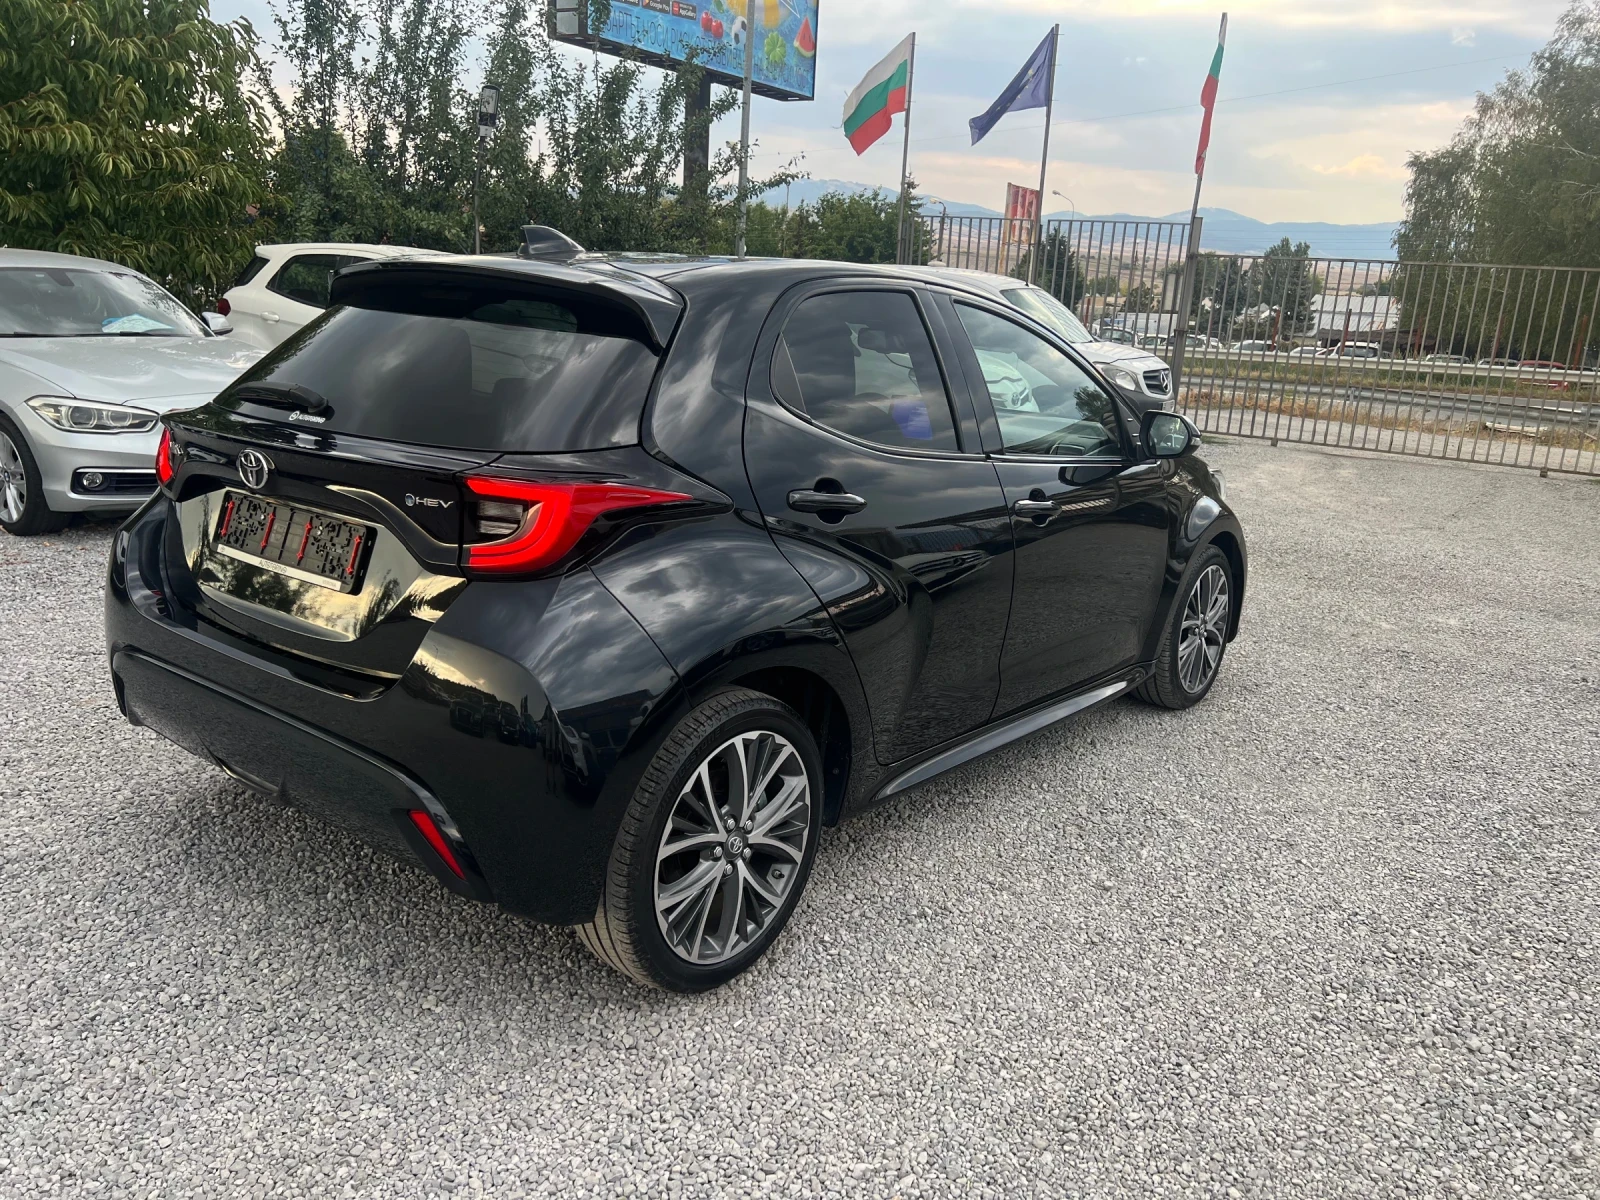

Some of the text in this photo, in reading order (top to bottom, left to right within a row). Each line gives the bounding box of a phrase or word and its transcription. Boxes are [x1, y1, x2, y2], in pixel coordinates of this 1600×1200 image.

[649, 1, 663, 10] Google
[679, 9, 697, 19] AppGallery
[415, 496, 455, 509] HEV
